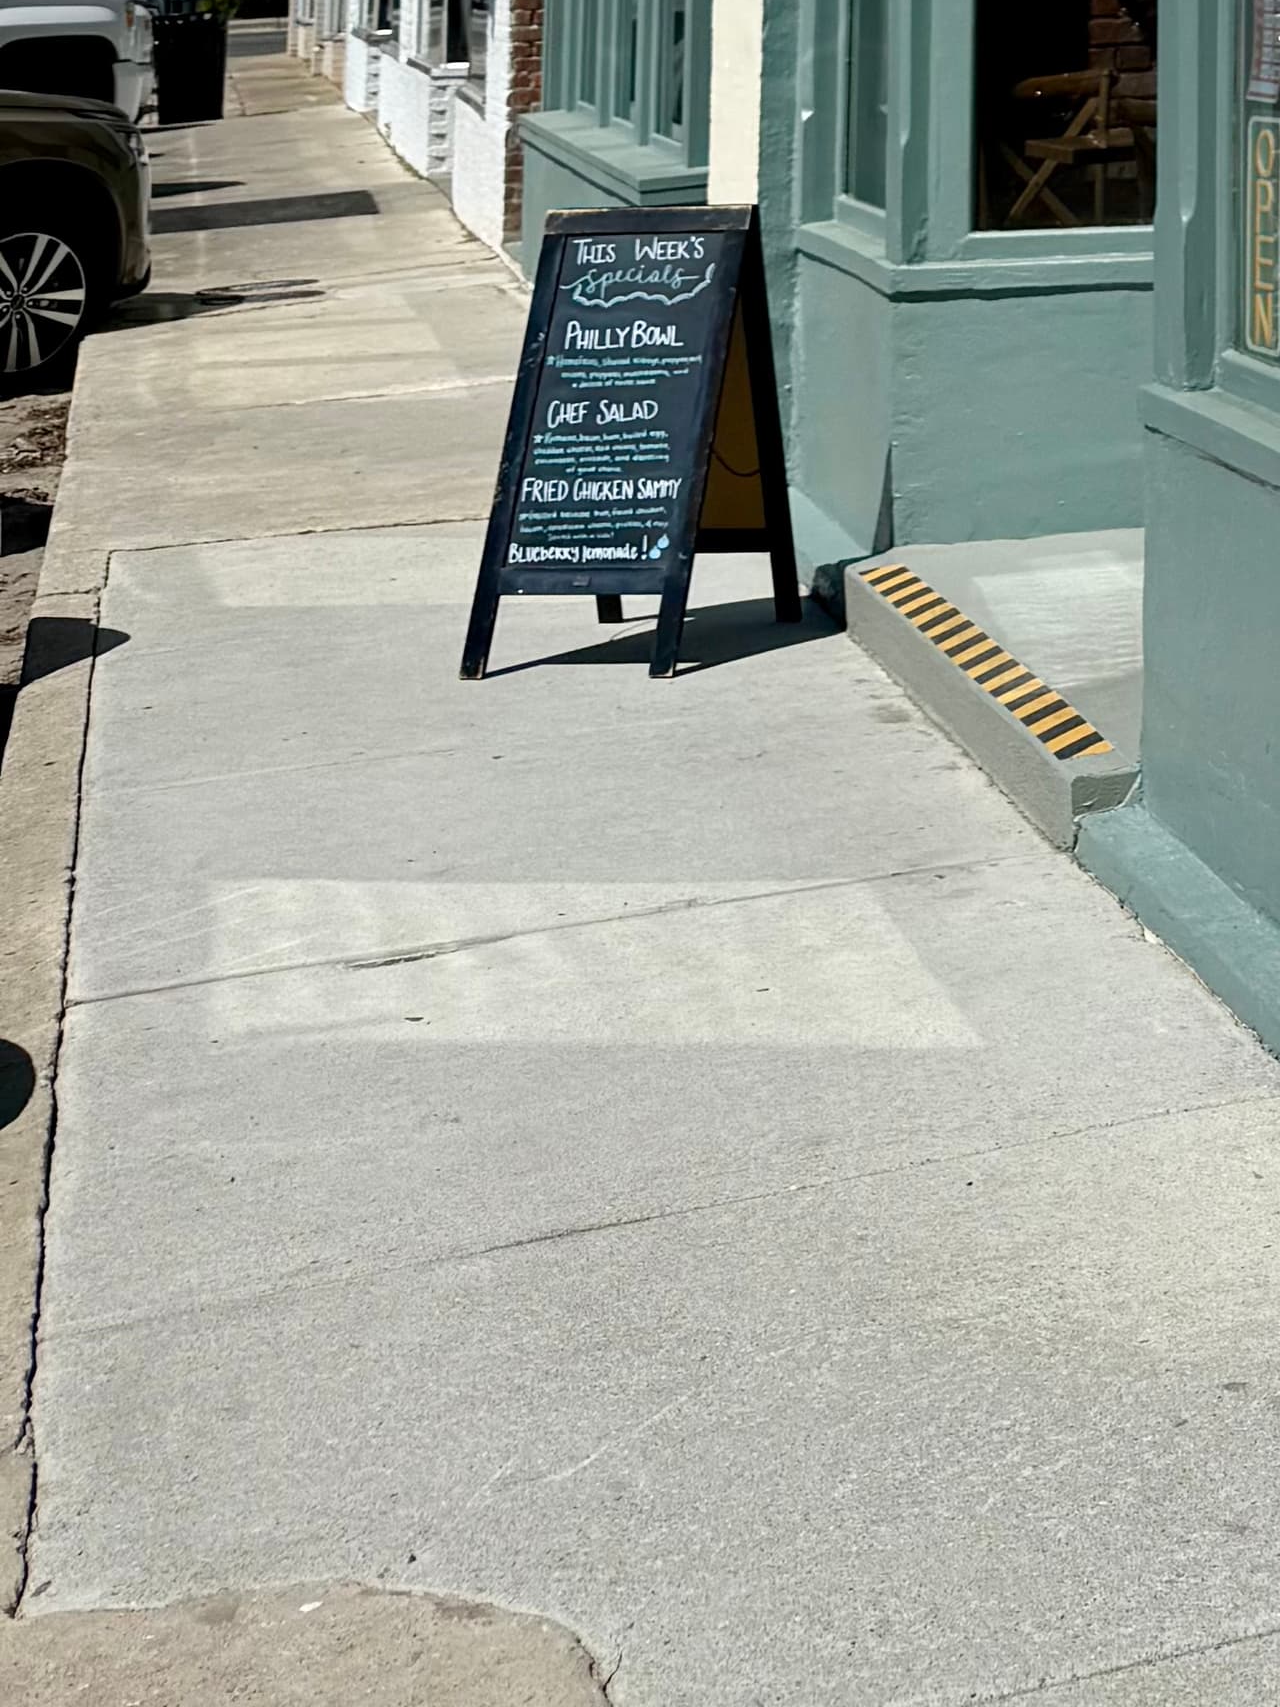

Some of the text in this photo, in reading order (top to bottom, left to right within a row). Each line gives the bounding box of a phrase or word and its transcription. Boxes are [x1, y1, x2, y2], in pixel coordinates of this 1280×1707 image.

[572, 235, 705, 266] THIS WEEK'S
[1254, 128, 1276, 349] OPEN
[564, 319, 684, 350] PHILLY BOWL
[546, 399, 659, 429] CHEF SALAD
[521, 477, 682, 503] FRIED CHICKEN SAMMY
